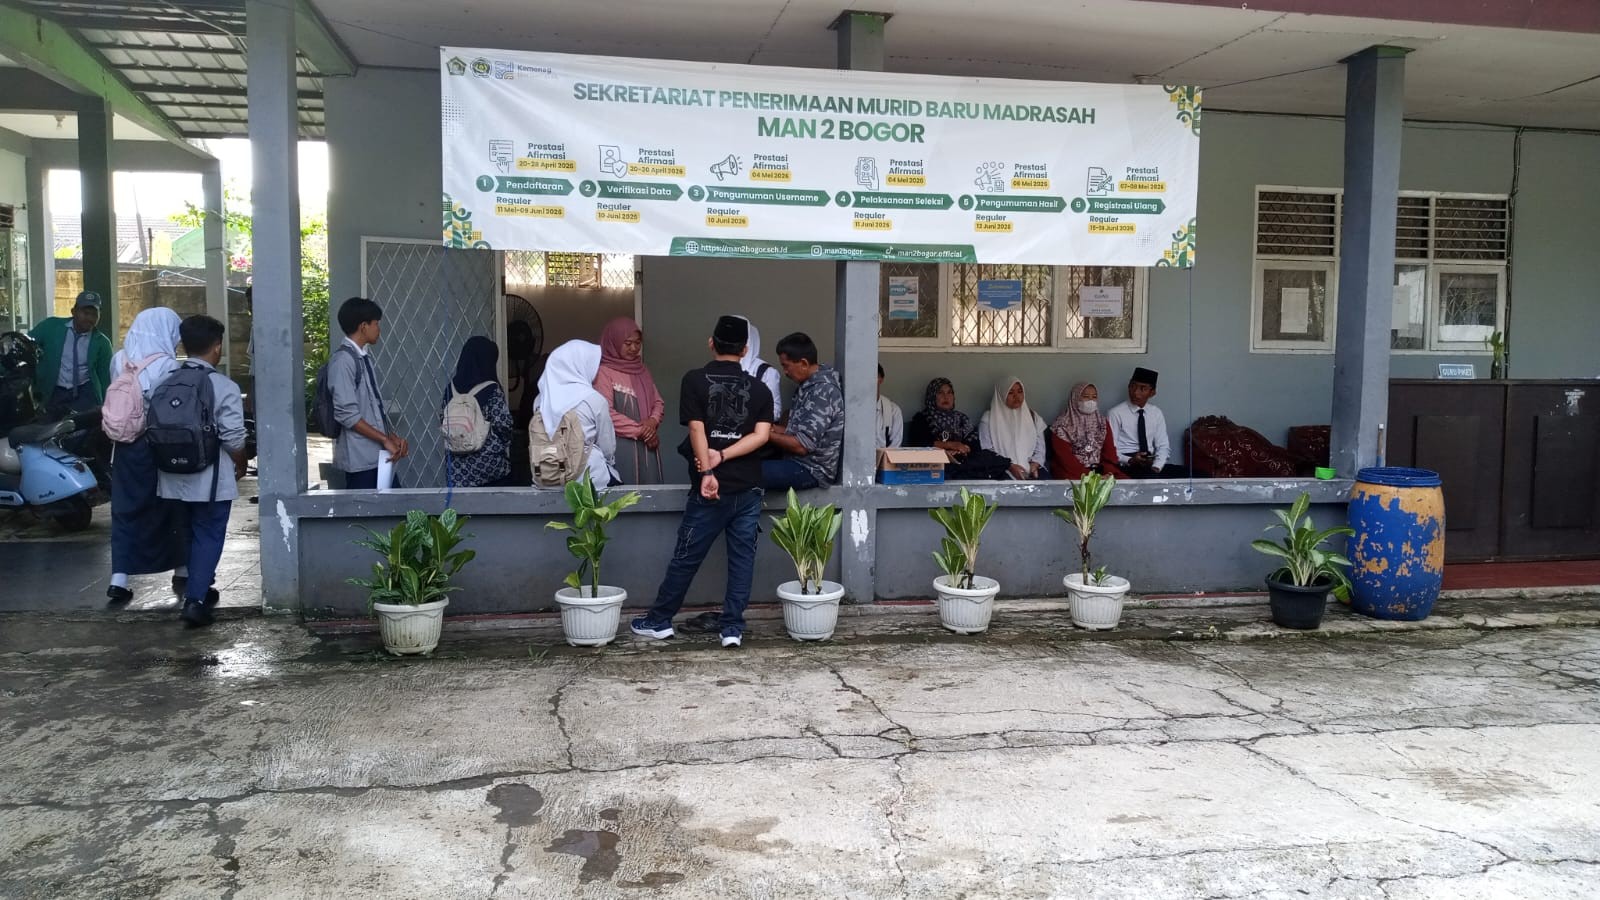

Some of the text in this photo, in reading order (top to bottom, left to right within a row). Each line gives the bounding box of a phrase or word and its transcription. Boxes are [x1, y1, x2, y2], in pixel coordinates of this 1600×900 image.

[573, 82, 1096, 125] SEKRETARIAT PENERIMAAN MURID BARU MADRASAH
[758, 116, 925, 143] MAN 2 BOGOR
[528, 142, 565, 151] Prestasi
[527, 151, 566, 160] Afirmasi
[638, 148, 675, 157] Prestasi
[637, 156, 675, 165] Afirmasi
[753, 153, 788, 162] Prestasi
[540, 161, 557, 169] April
[752, 162, 789, 170] Afirmasi
[890, 159, 923, 167] Prestasi
[1014, 163, 1047, 171] Prestasi
[651, 167, 667, 175] April
[889, 167, 923, 175] Afirmasi
[1126, 166, 1158, 174] Prestasi
[1013, 171, 1048, 179] Afirmasi
[1125, 174, 1159, 182] Afirmasi
[506, 181, 563, 191] Pendaftaran
[585, 184, 672, 196] 2 Verifikasi Data
[496, 196, 531, 205] Reguler
[713, 190, 774, 201] Pengumuman
[775, 192, 819, 203] Username
[860, 195, 914, 205] Pelaksanaan
[915, 197, 944, 206] Seleksi
[597, 203, 632, 212] Reguler
[980, 199, 1038, 208] Pengumuman
[1039, 200, 1058, 208] Hasil
[1094, 201, 1133, 211] Registrasi
[1134, 202, 1158, 212] Ulang
[707, 208, 740, 217] Reguler
[854, 211, 886, 220] Reguler
[975, 214, 1007, 222] Reguler
[1089, 216, 1119, 224] Reguler
[824, 247, 864, 256] man2bogor
